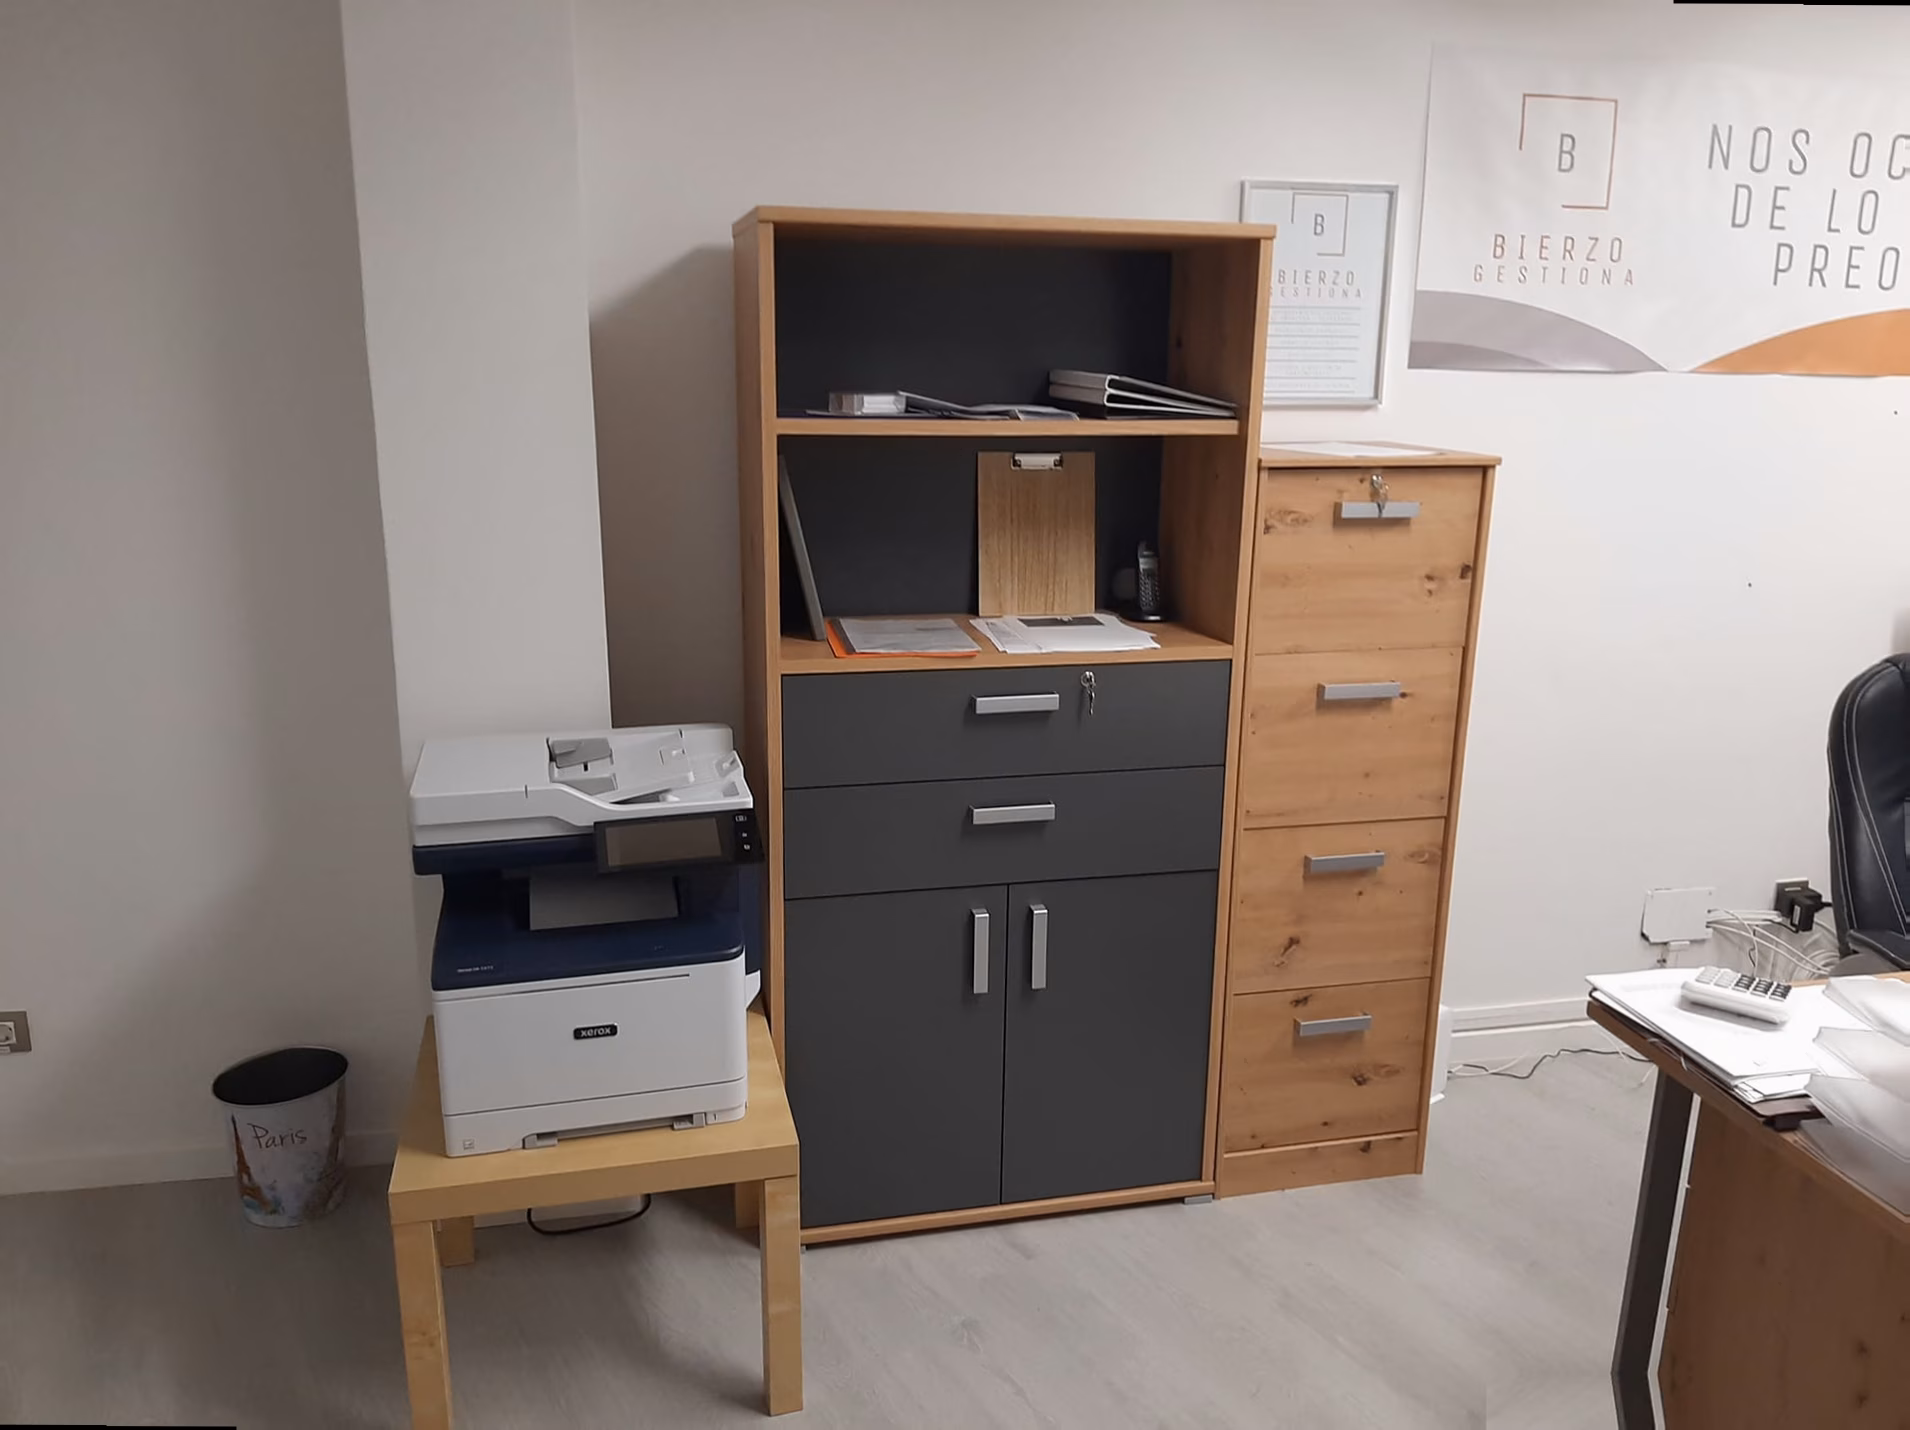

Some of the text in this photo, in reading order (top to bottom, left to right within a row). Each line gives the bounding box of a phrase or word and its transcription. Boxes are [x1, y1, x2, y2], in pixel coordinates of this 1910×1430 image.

[1557, 132, 1576, 173] B
[1708, 123, 1810, 175] NOS
[1731, 183, 1879, 235] DE LO
[1312, 213, 1325, 237] B
[1492, 233, 1623, 263] BIERZO
[1277, 268, 1355, 287] BIERZO
[1473, 264, 1634, 286] GESTIONA
[1773, 242, 1900, 291] PREO
[580, 1025, 612, 1038] xerox
[247, 1123, 307, 1149] Paris
